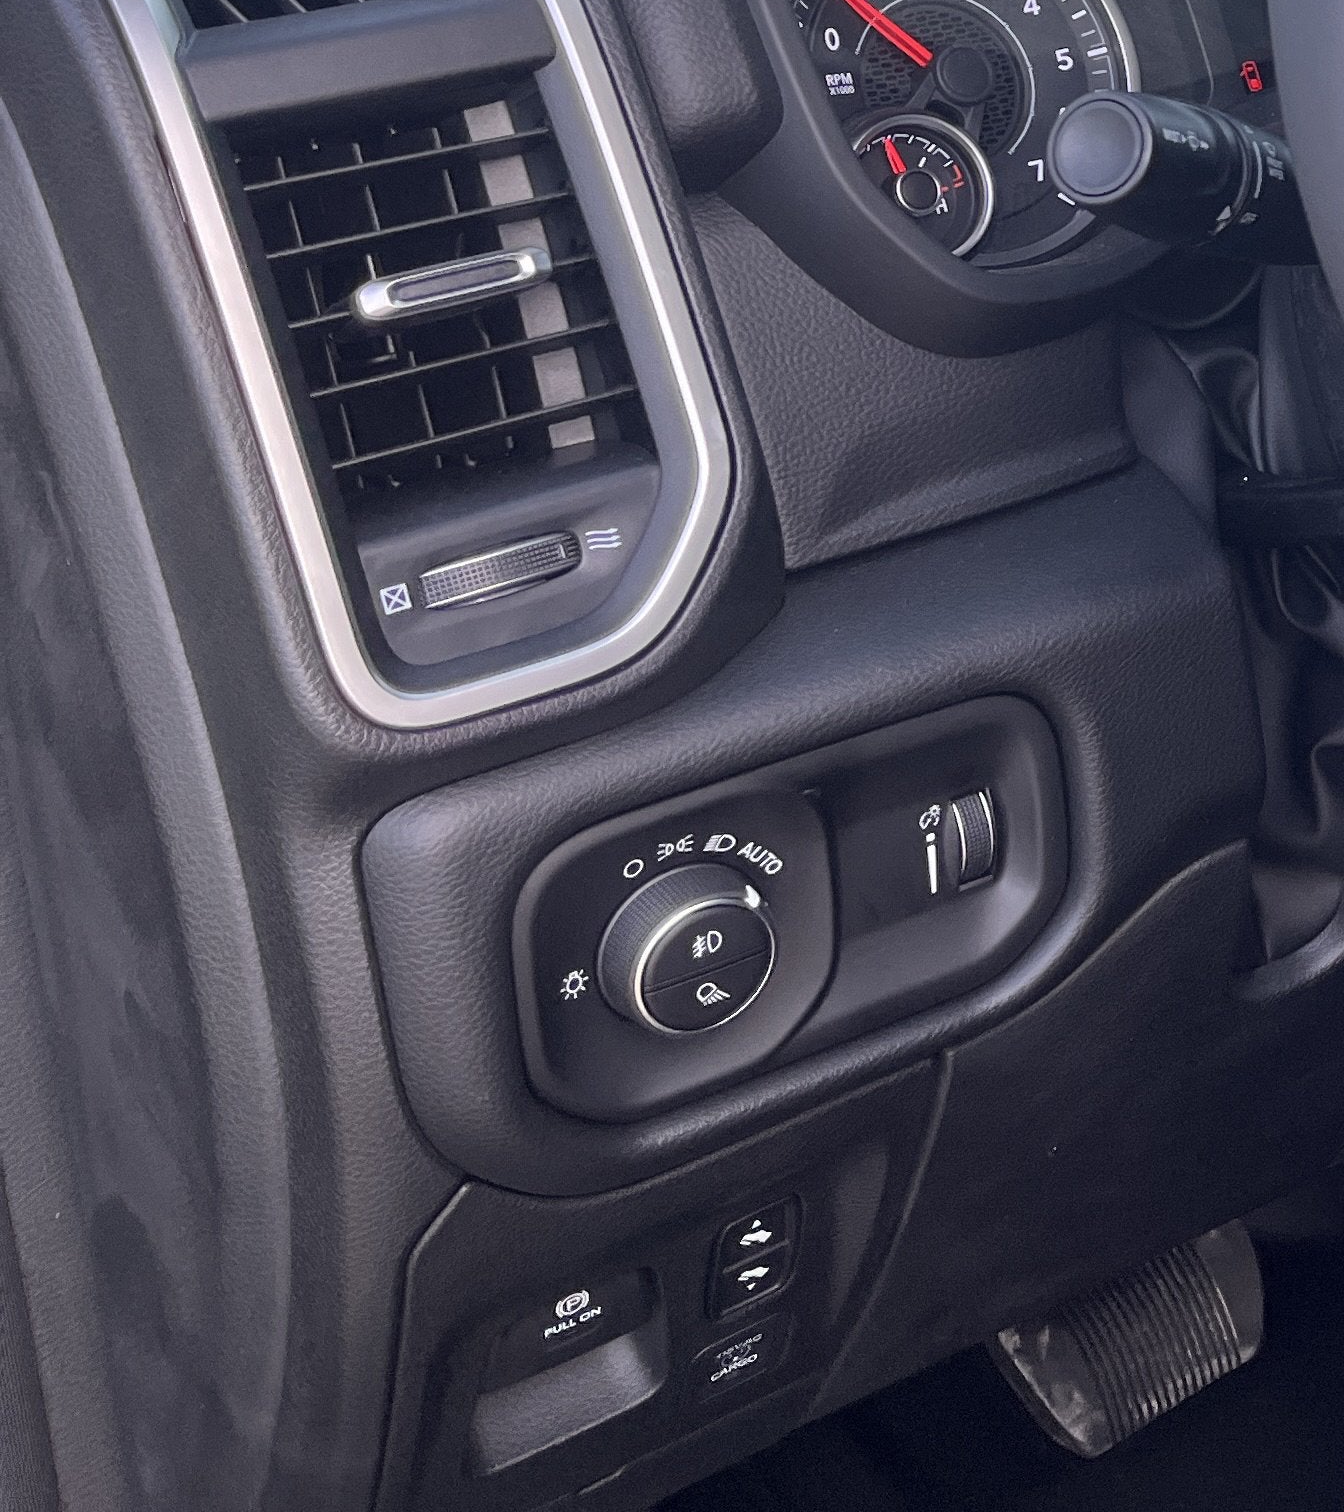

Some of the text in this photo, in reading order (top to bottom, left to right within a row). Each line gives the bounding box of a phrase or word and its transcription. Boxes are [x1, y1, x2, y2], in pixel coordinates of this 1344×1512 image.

[824, 27, 841, 51] 0
[1054, 47, 1075, 71] 5
[825, 72, 854, 87] RPM
[1027, 159, 1045, 182] 7
[737, 842, 784, 876] AUTO
[544, 1306, 602, 1339] PULL ON
[710, 1353, 758, 1382] CARGO
